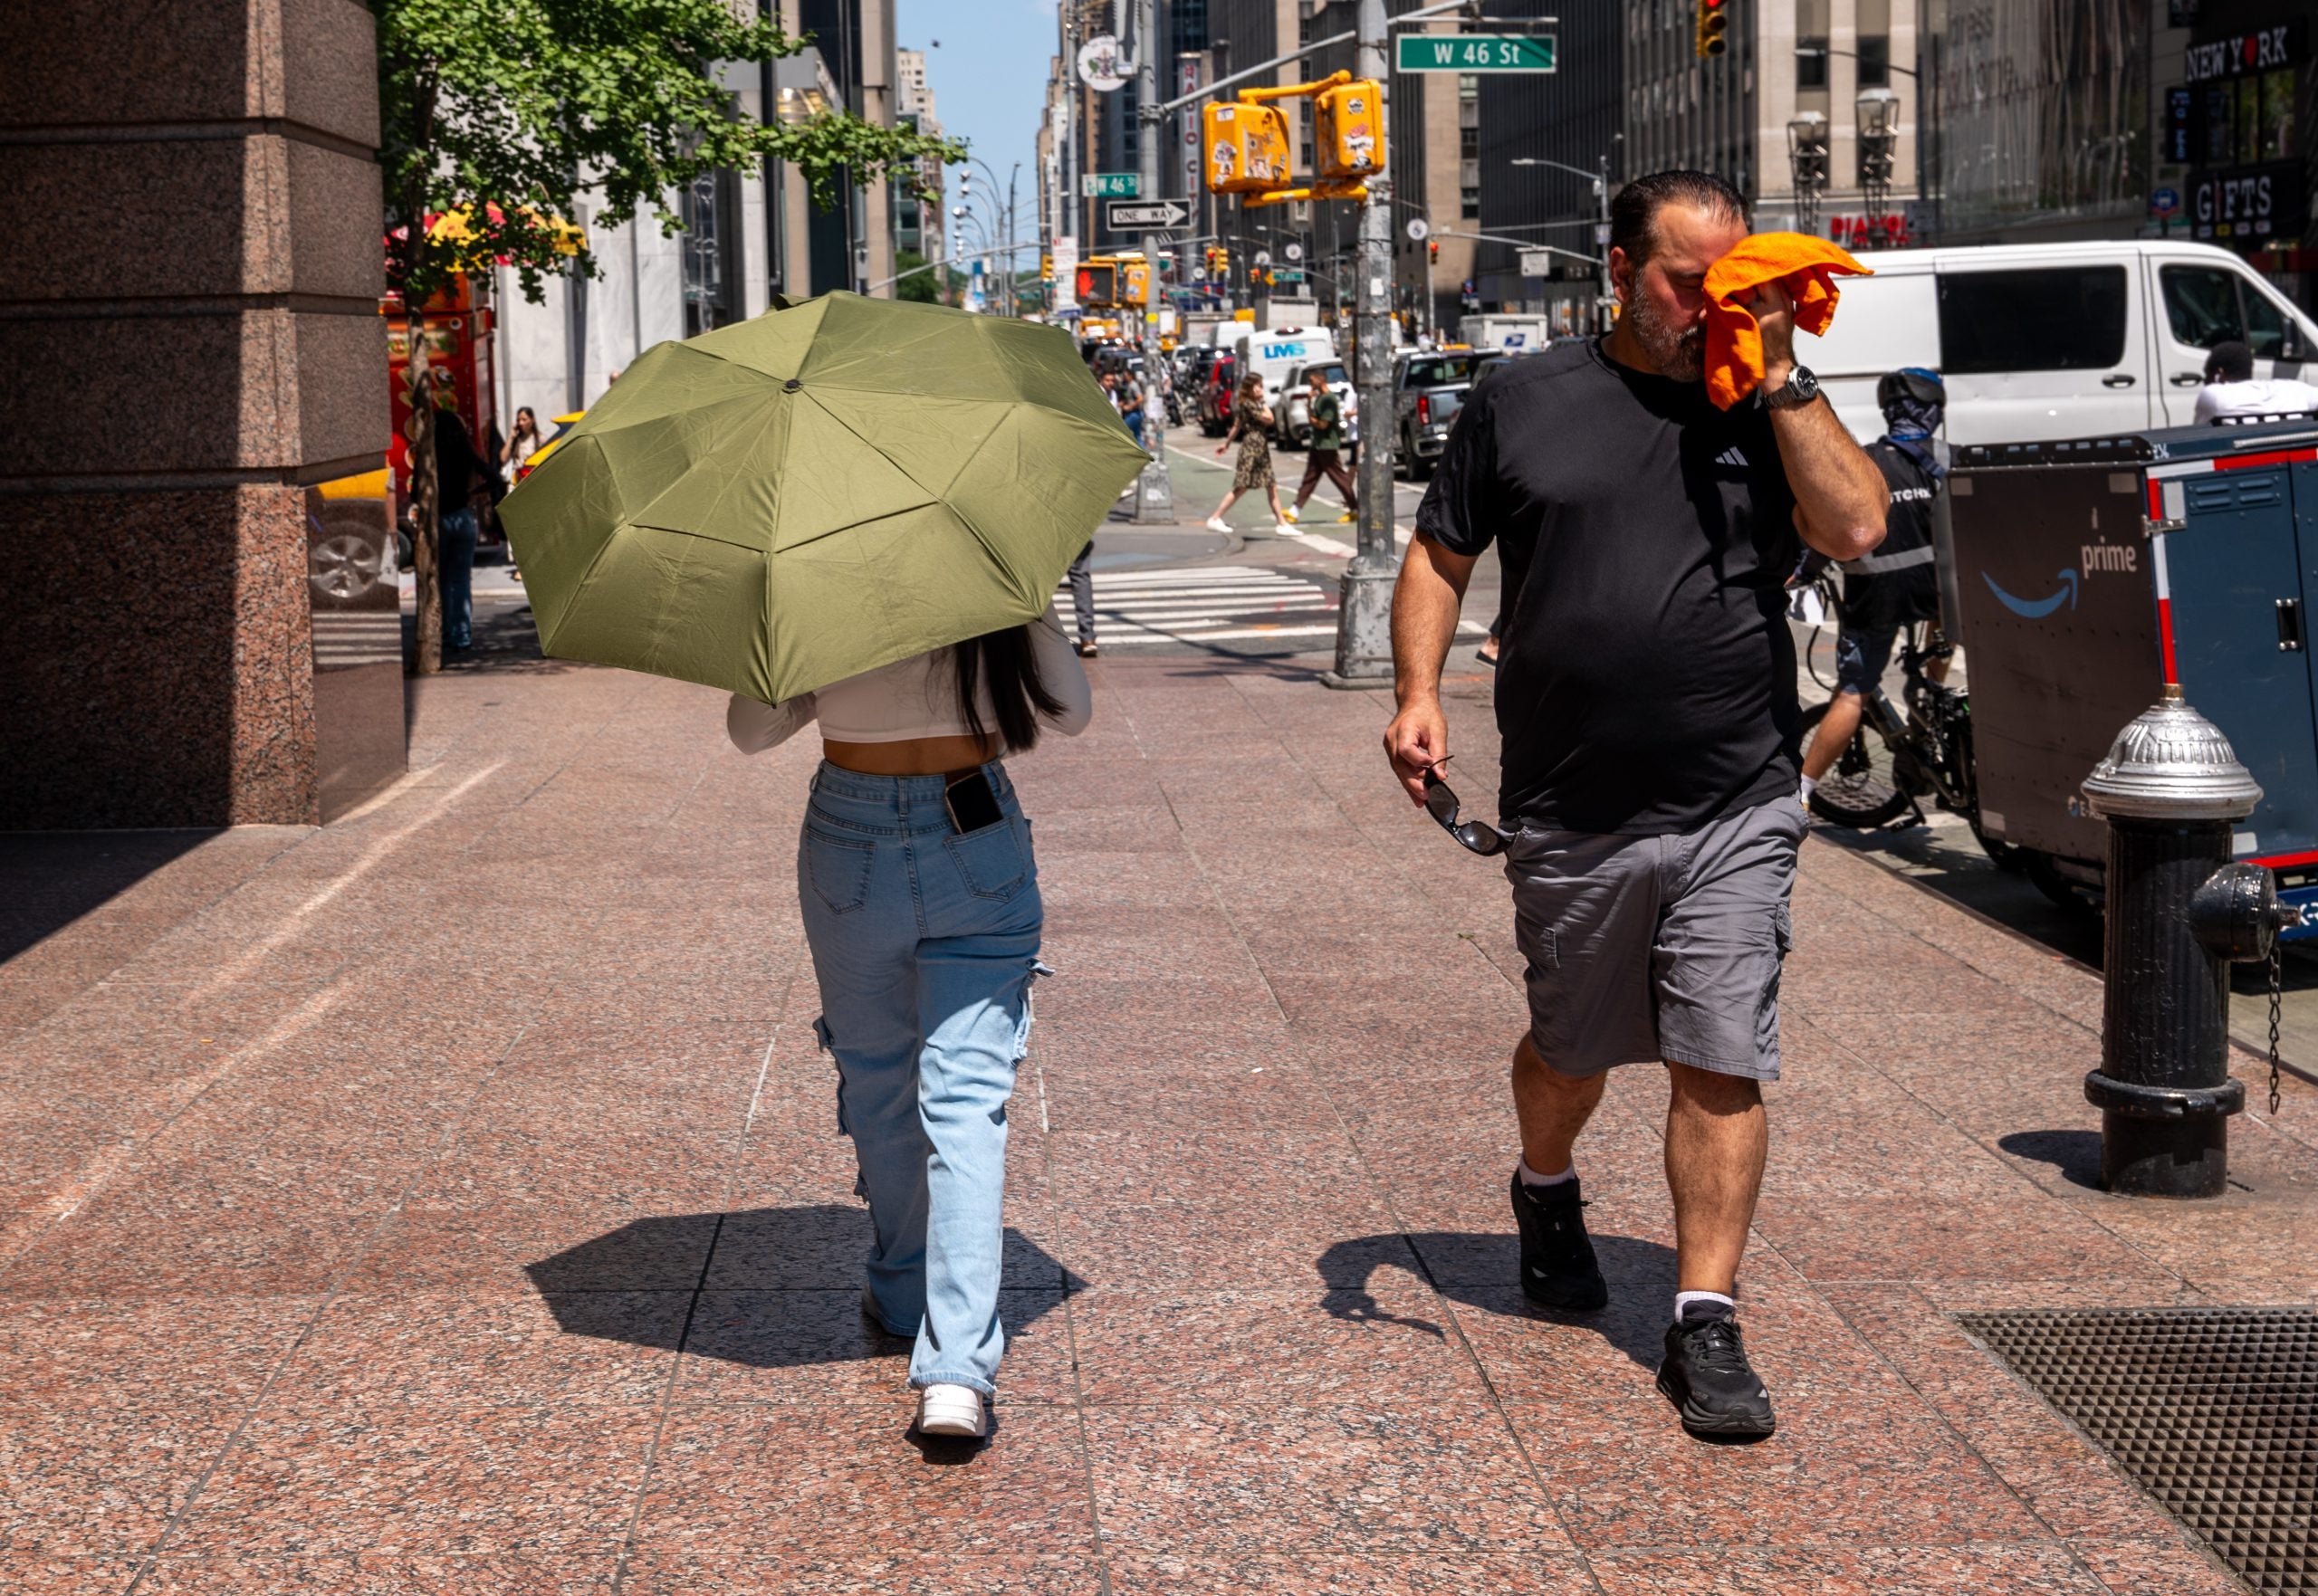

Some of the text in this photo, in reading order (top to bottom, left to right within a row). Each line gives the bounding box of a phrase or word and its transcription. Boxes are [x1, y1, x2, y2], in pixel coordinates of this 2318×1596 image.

[1433, 43, 1520, 65] W 46 St
[2186, 41, 2226, 82] NEW
[1183, 64, 1198, 145] RADIO
[1097, 177, 1107, 194] W
[1110, 177, 1125, 194] 46
[1116, 208, 1174, 223] ONE WAY
[2082, 535, 2137, 579] prime
